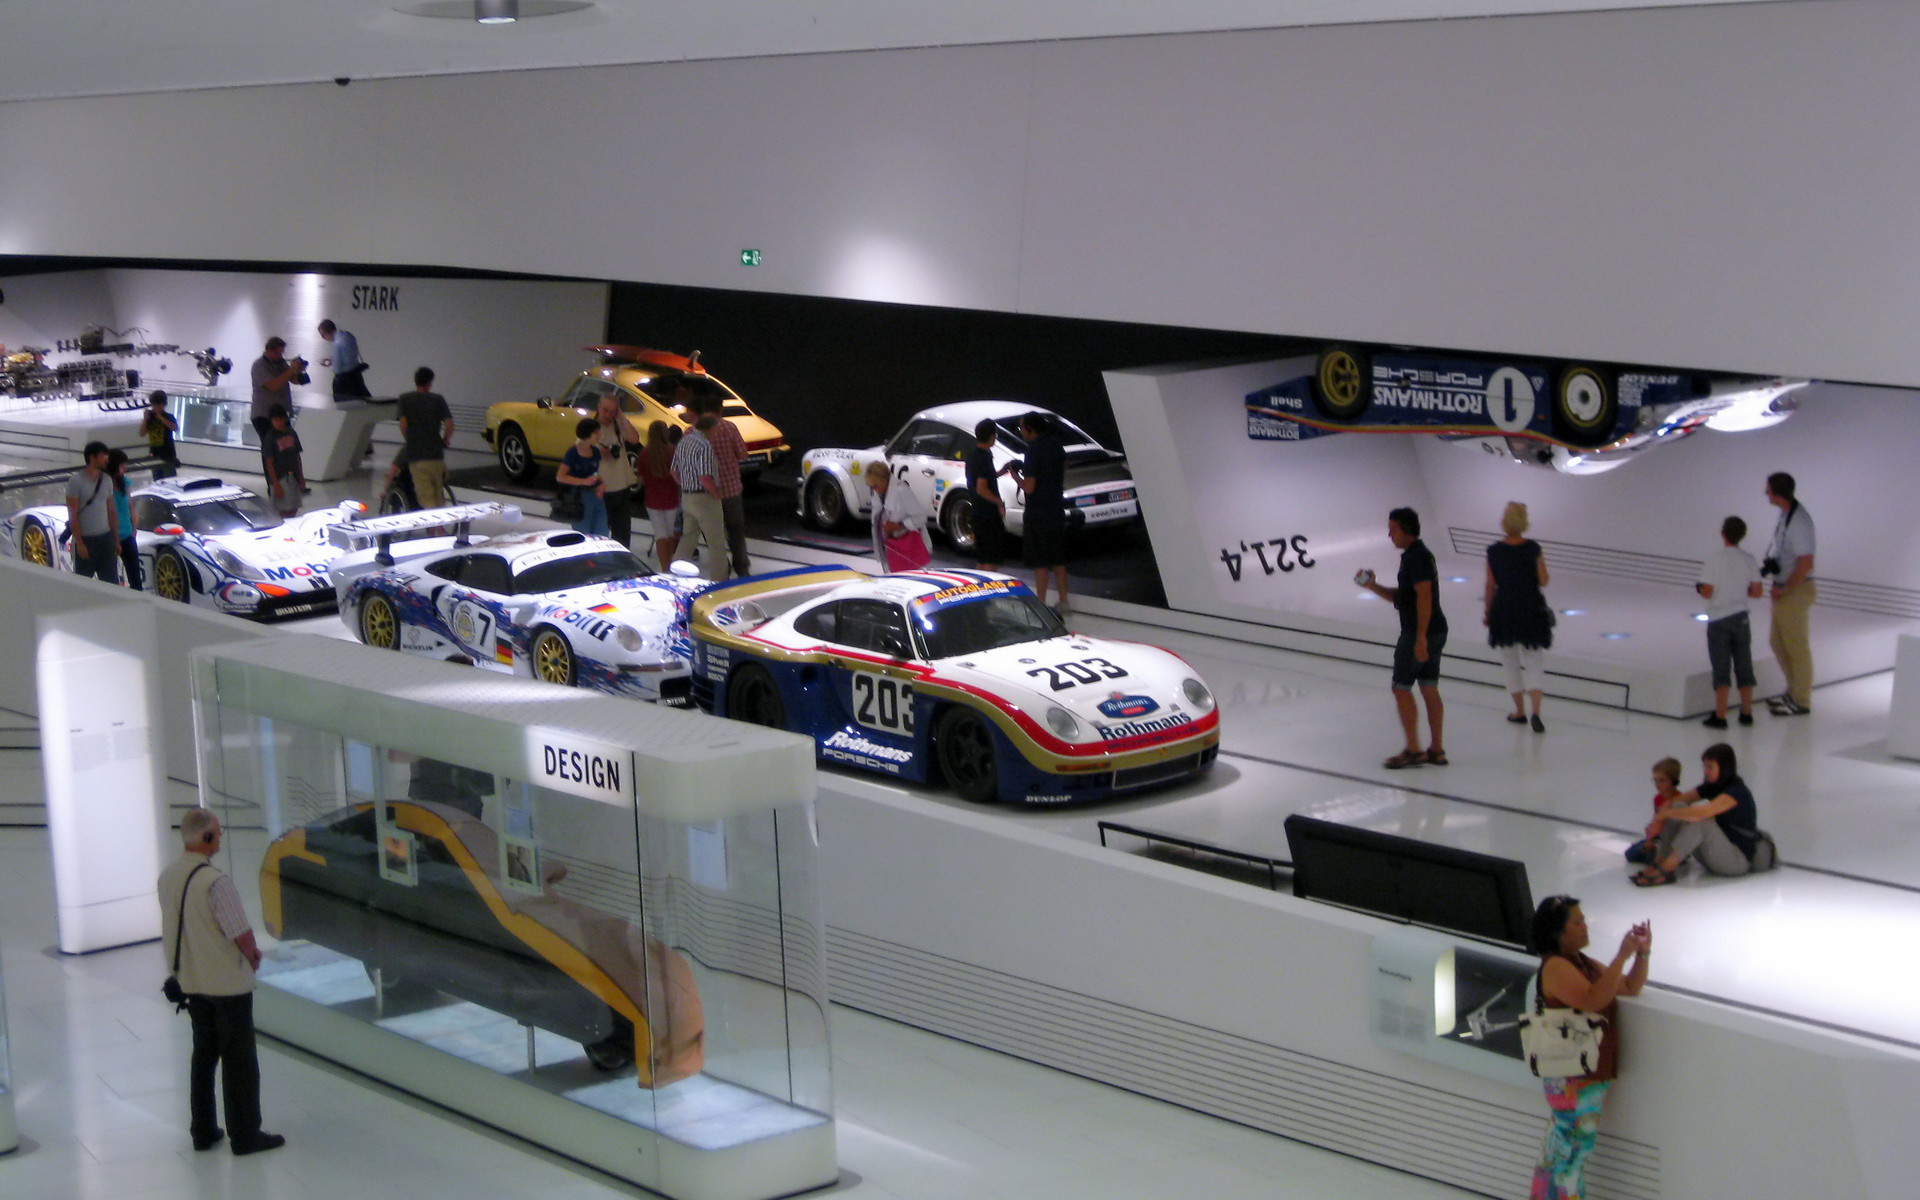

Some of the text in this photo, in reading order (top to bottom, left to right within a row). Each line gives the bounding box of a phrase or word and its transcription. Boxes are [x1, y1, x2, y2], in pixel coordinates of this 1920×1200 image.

[352, 285, 399, 311] STARK
[1373, 366, 1483, 387] PORSCHE
[1270, 396, 1303, 409] Shell
[1373, 386, 1483, 415] ROTHMANS
[1503, 377, 1518, 423] 1
[1249, 424, 1300, 440] ROTHMANS
[1220, 534, 1316, 582] 321,4
[933, 580, 1006, 601] AUTOGLASS
[938, 588, 1010, 606] PORSCHE
[478, 611, 491, 647] 7
[540, 604, 598, 631] Mobil
[1026, 658, 1129, 692] 203
[855, 674, 914, 733] 203
[1106, 699, 1149, 712] Rothmans
[1097, 712, 1192, 741] Rothmans
[824, 730, 913, 763] Rothmans
[544, 745, 621, 792] DESIGN
[823, 747, 900, 774] PORSCHE
[1025, 795, 1072, 803] DUNLOP
